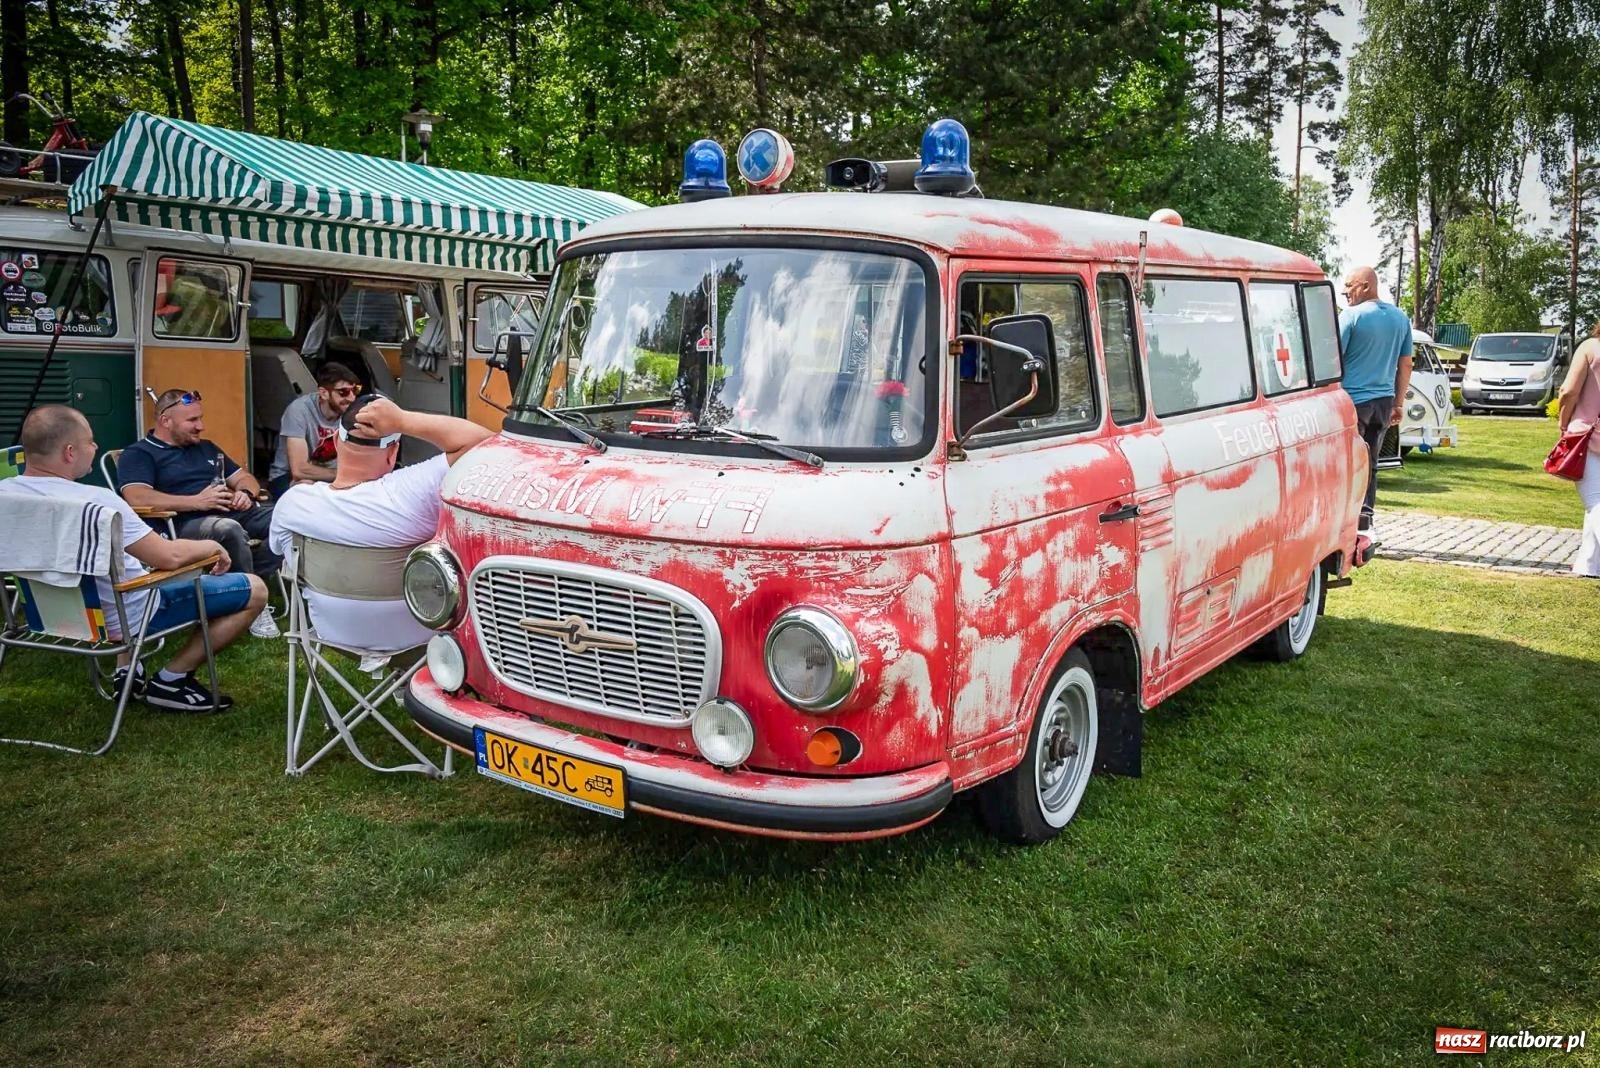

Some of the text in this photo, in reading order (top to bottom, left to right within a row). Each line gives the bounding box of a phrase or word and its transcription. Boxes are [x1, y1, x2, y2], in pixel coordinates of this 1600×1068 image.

[1212, 405, 1322, 462] Feuerwehr
[479, 752, 488, 764] PL
[490, 739, 522, 778] OK
[530, 752, 579, 794] 45C
